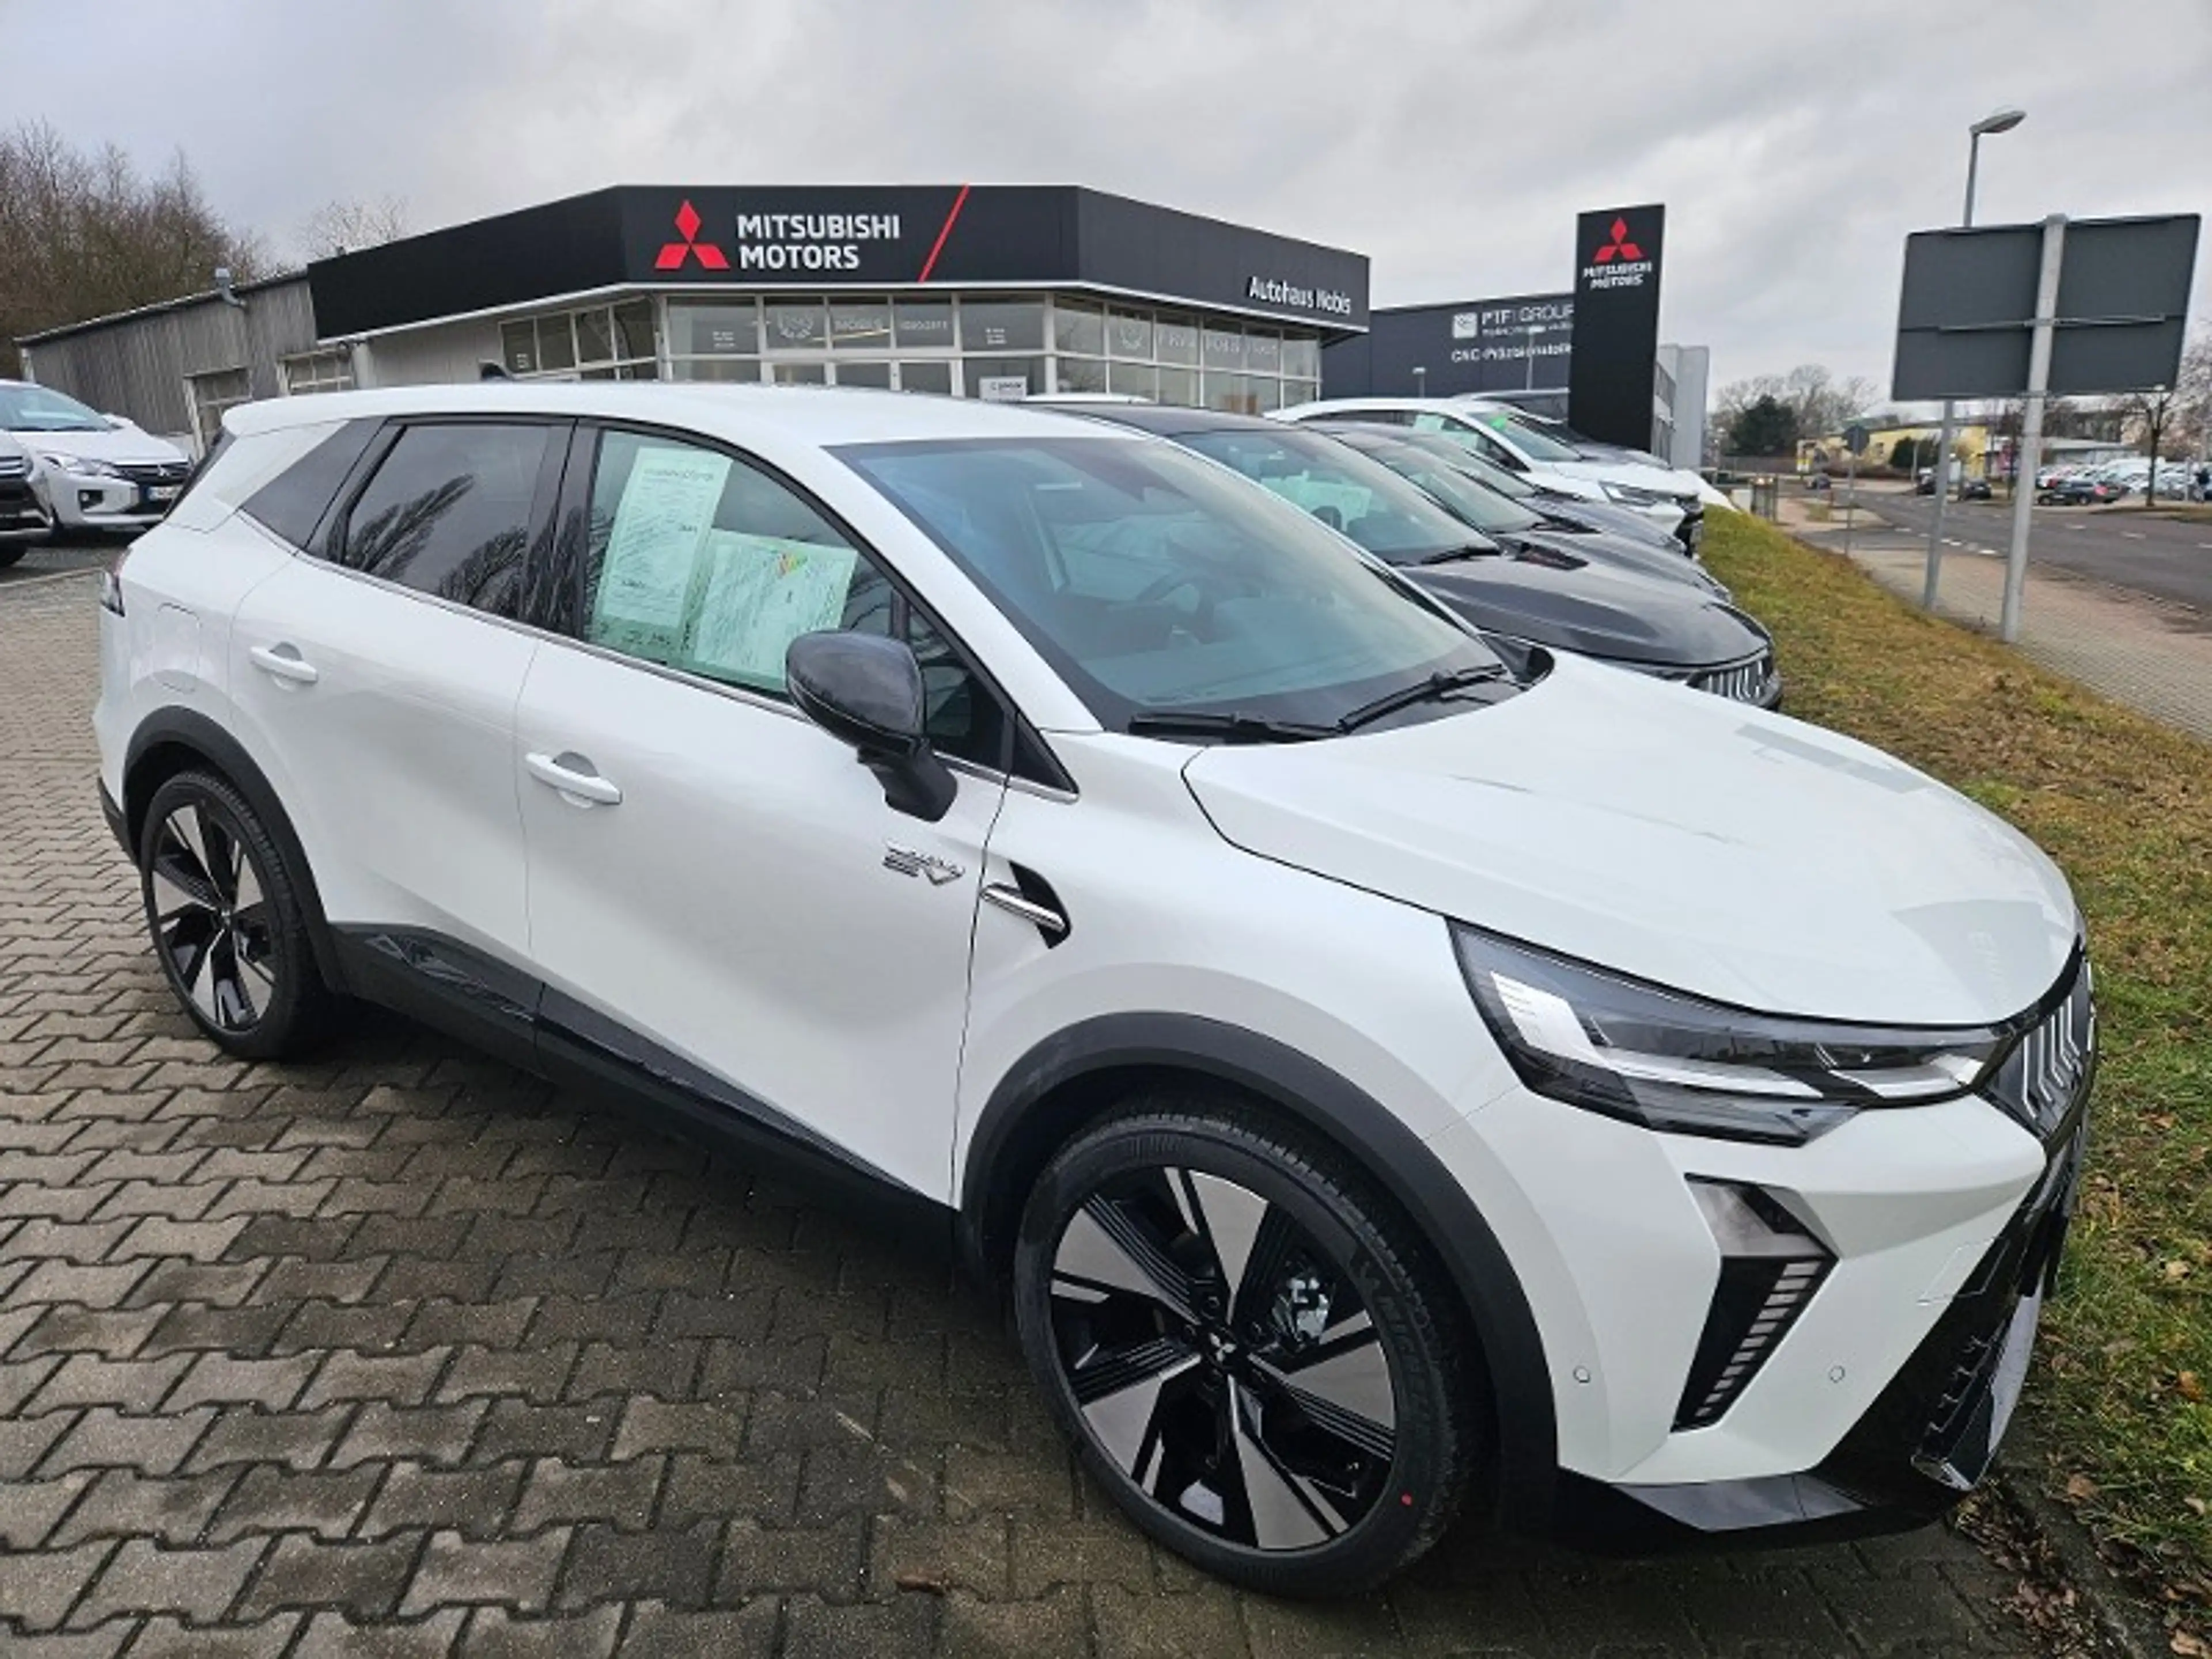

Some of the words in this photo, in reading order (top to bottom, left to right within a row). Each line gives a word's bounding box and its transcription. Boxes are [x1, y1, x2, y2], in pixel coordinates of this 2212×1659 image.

[737, 214, 900, 239] MITSUBISHI
[739, 244, 861, 270] MOTORS
[1583, 261, 1652, 278] MITSUBISHI
[1590, 274, 1643, 290] MOTORS
[1249, 276, 1315, 309] Autohaus
[1316, 288, 1351, 315] Nobis
